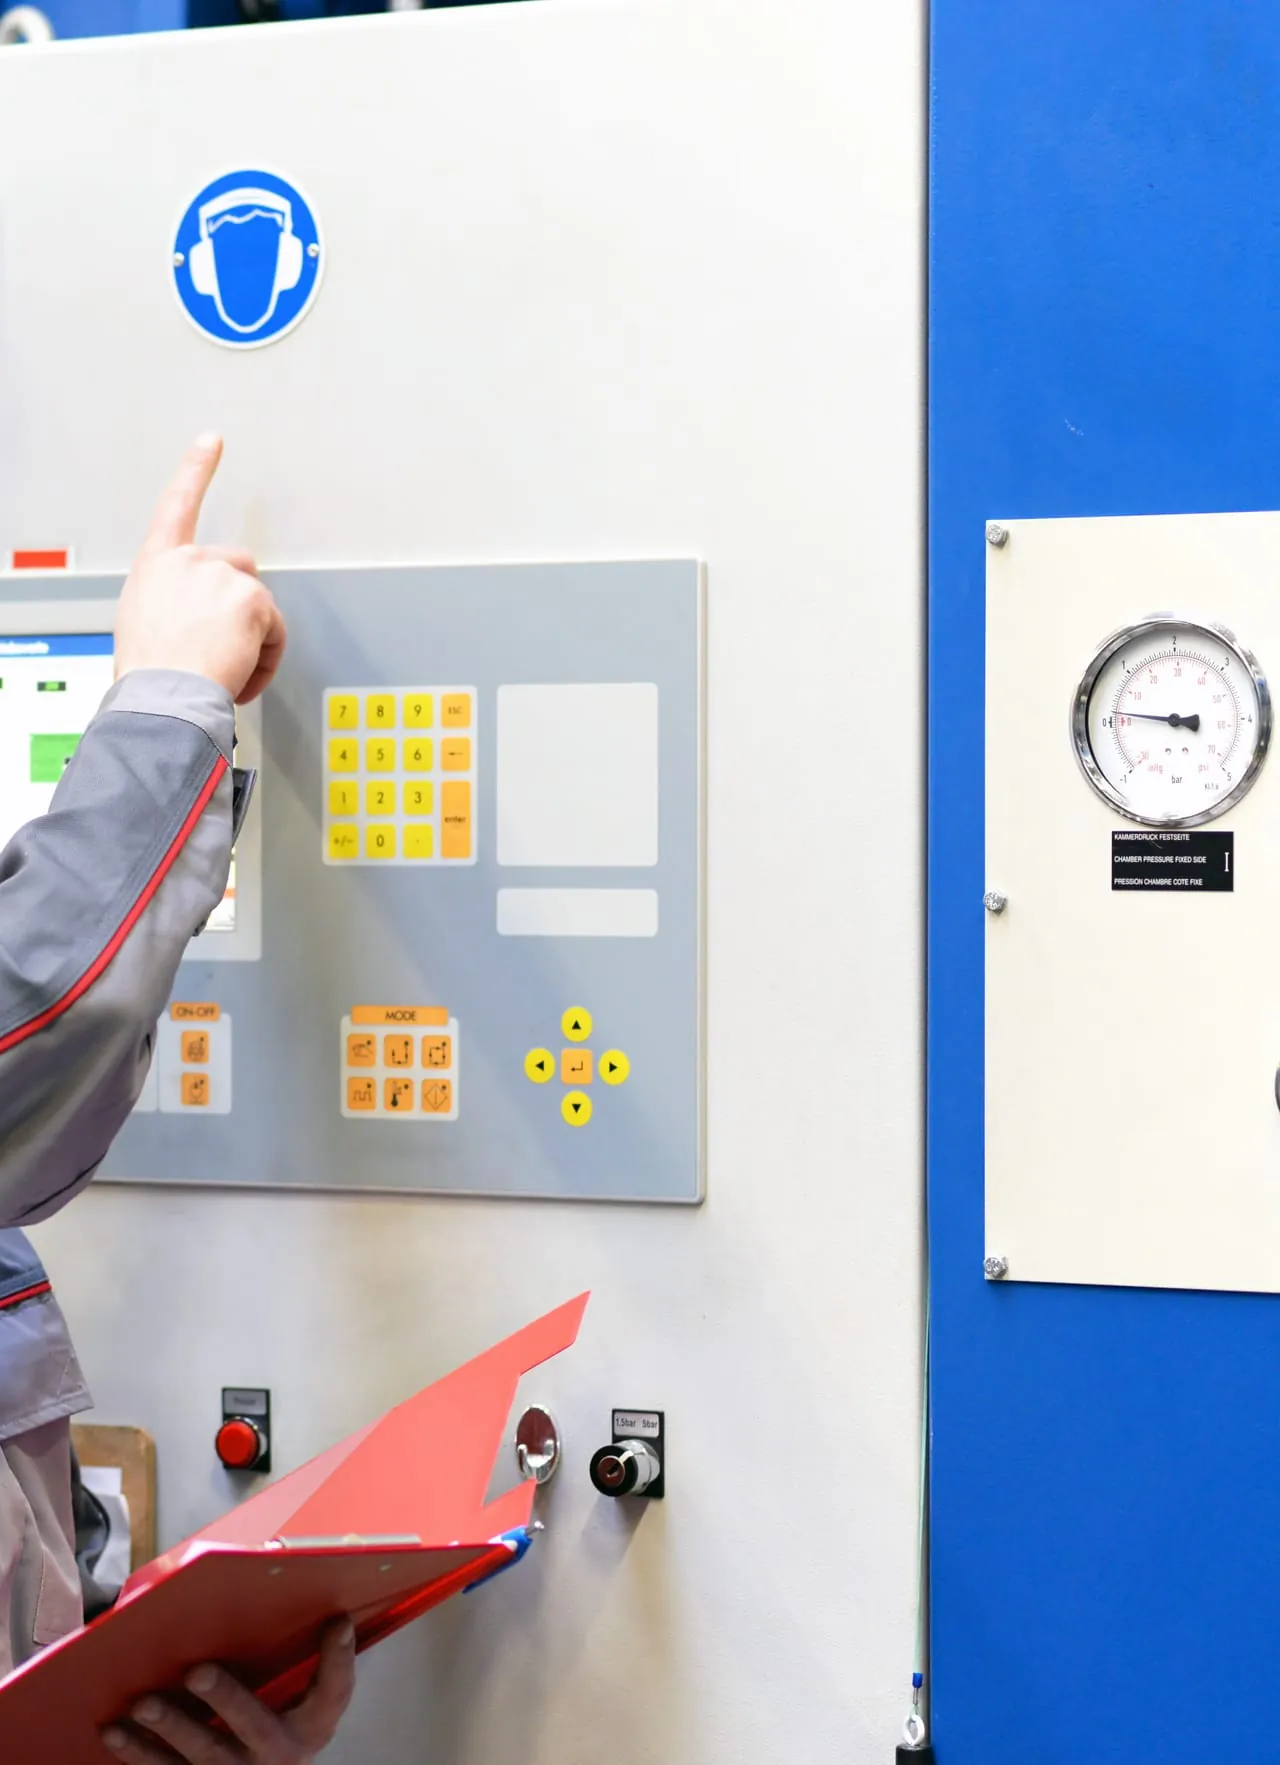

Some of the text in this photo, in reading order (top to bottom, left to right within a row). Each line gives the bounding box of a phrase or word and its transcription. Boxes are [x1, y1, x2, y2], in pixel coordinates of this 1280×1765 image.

[1149, 675, 1158, 685] 20
[1134, 691, 1142, 701] 10
[339, 704, 348, 718] 7
[376, 704, 385, 718] 8
[413, 704, 423, 718] 9
[339, 748, 422, 761] 4 5 6
[1171, 775, 1183, 785] bar
[341, 791, 422, 804] 1 2 3
[444, 815, 467, 824] enter
[376, 834, 385, 847] 0
[1114, 833, 1190, 841] KAMMERDRUCK FESTSEITE
[1114, 855, 1207, 864] CHAMBER PRESSURE FIXED SIDE
[1114, 878, 1143, 886] PRESSION
[1144, 878, 1172, 886] CHAMBRE
[1189, 878, 1203, 886] FIXE
[176, 1006, 216, 1018] ON-OFF
[384, 1010, 417, 1021] MODE
[642, 1419, 658, 1428] 5bar
